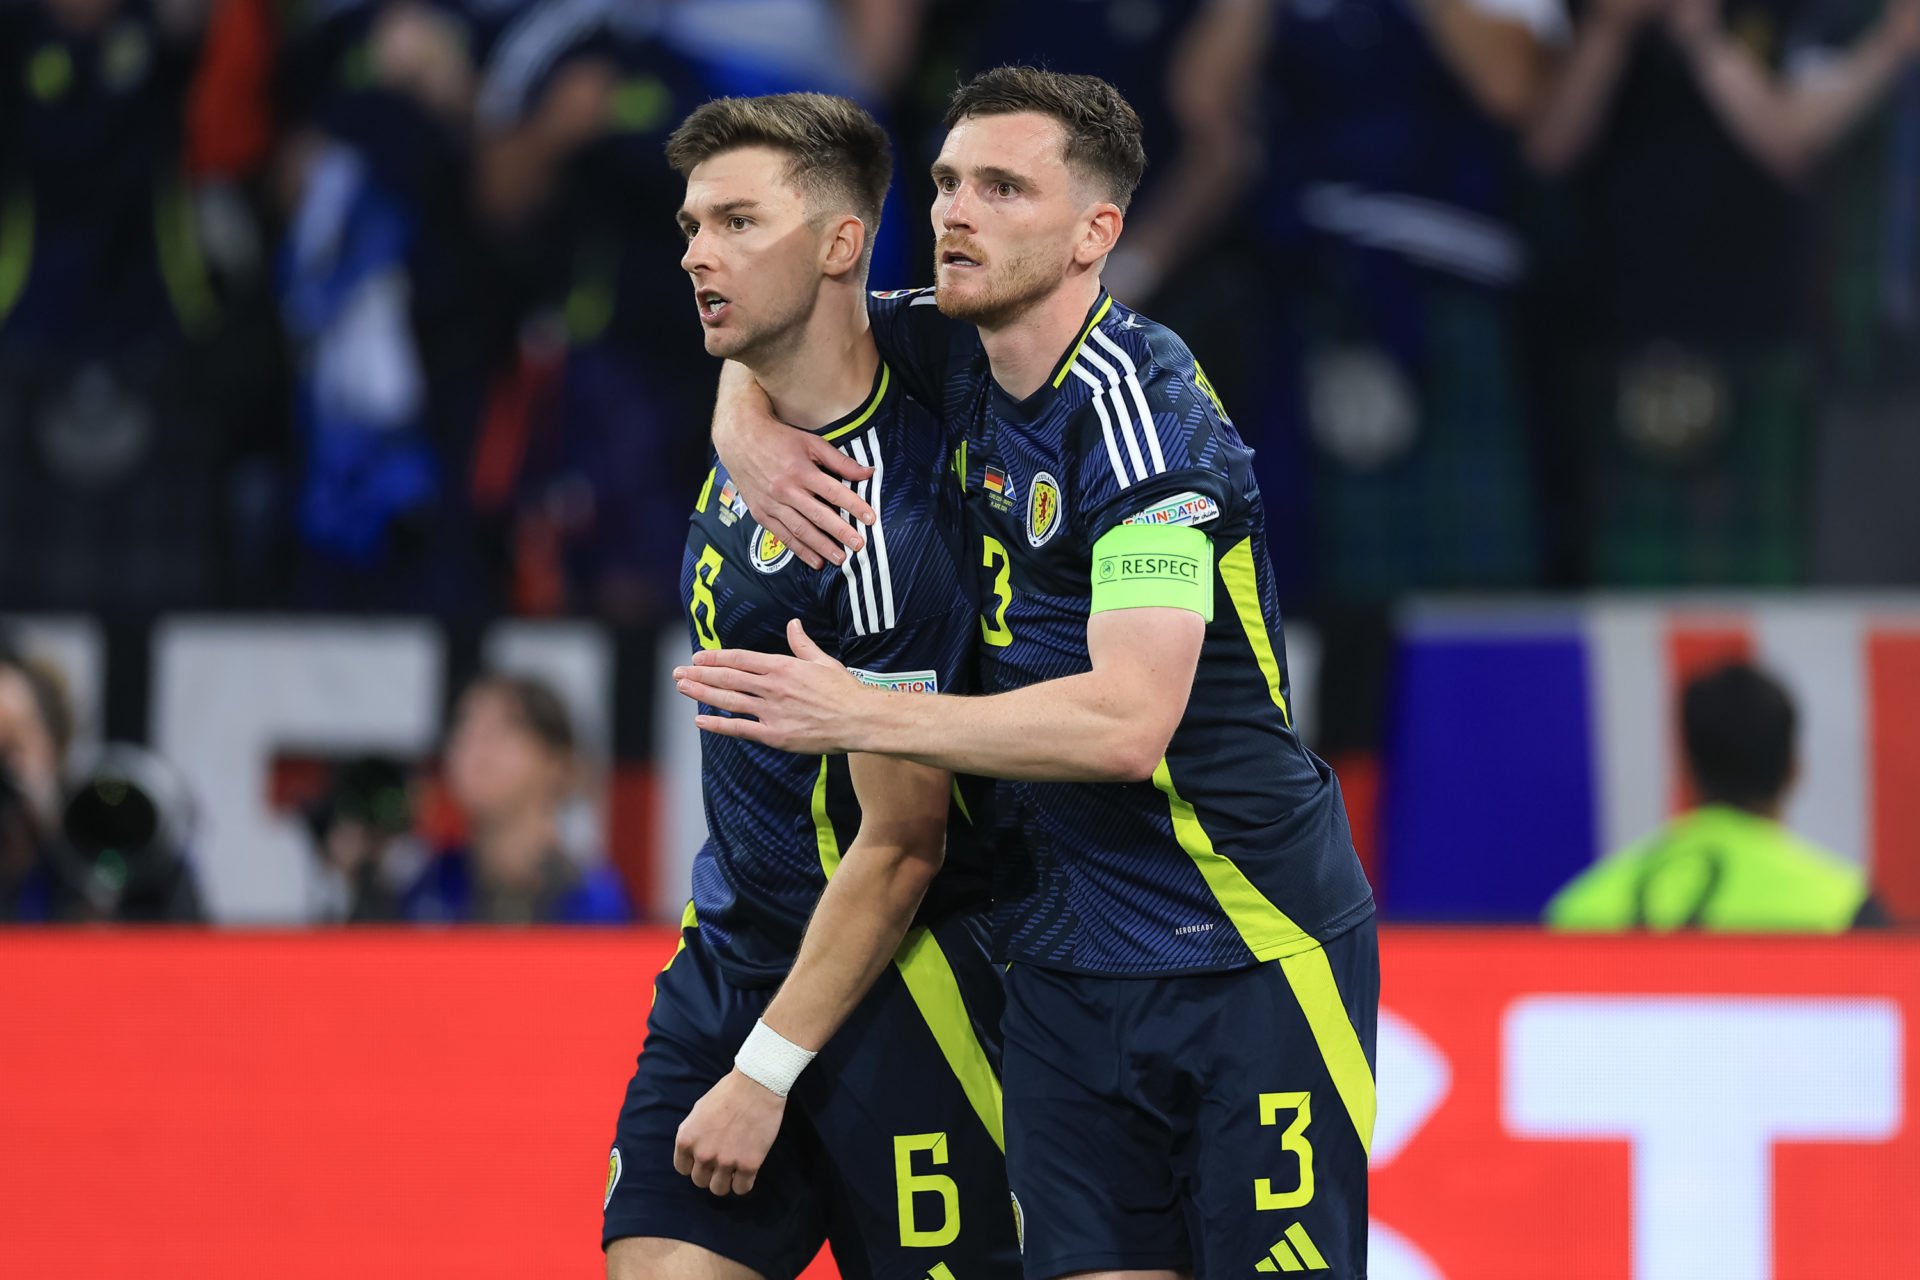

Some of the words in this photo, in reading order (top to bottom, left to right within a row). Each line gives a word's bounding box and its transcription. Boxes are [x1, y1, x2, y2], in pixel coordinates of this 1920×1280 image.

[690, 543, 724, 650] 6
[981, 535, 1013, 647] 3
[1122, 559, 1199, 579] RESPECT
[1175, 923, 1214, 936] AEROREADY
[894, 1132, 961, 1247] 6
[1254, 1091, 1315, 1211] 3
